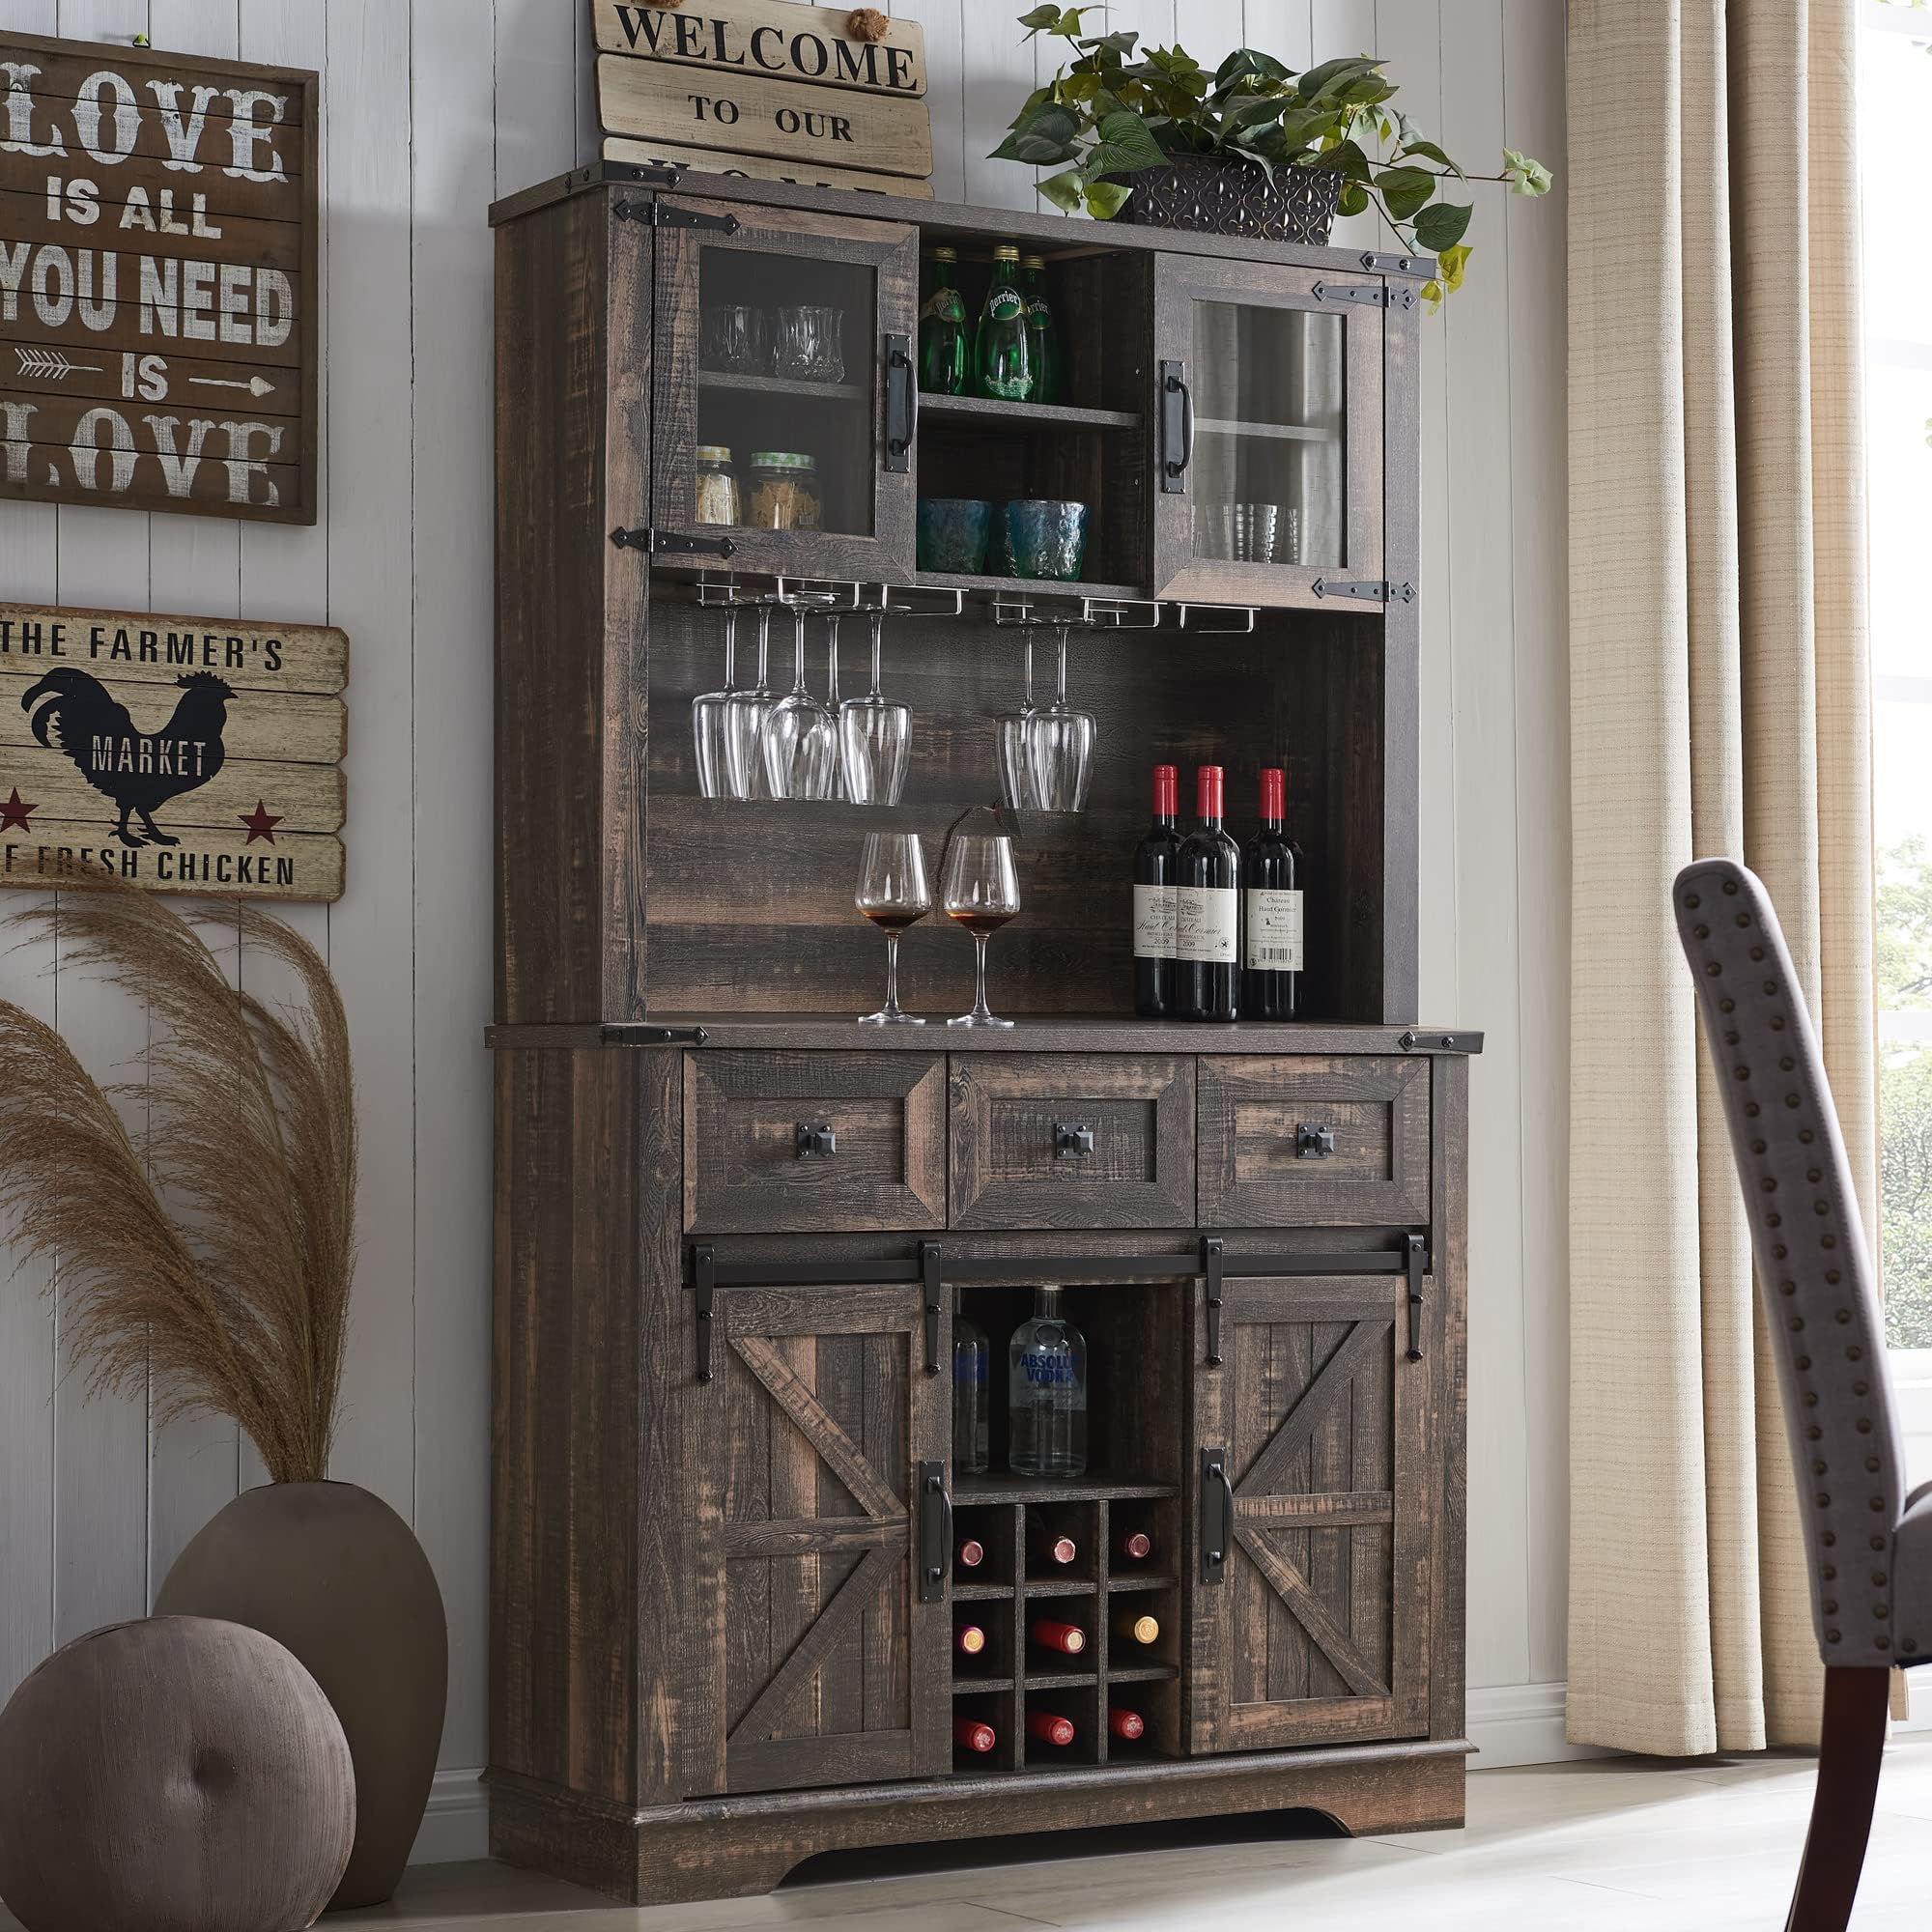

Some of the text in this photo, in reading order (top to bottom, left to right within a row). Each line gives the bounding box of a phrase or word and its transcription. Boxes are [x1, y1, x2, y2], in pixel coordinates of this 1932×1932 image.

[613, 4, 918, 91] WELCOME
[0, 62, 289, 184] LOVE
[688, 95, 854, 142] TO OUR
[46, 176, 221, 240] IS ALL
[0, 241, 293, 347] YOU NEED
[121, 353, 168, 402] IS
[0, 401, 284, 506] LOVE
[0, 621, 283, 671] THE FARMER'S
[92, 735, 206, 777] MARKET
[38, 846, 137, 877] FRESH
[157, 852, 294, 885] CHICKEN
